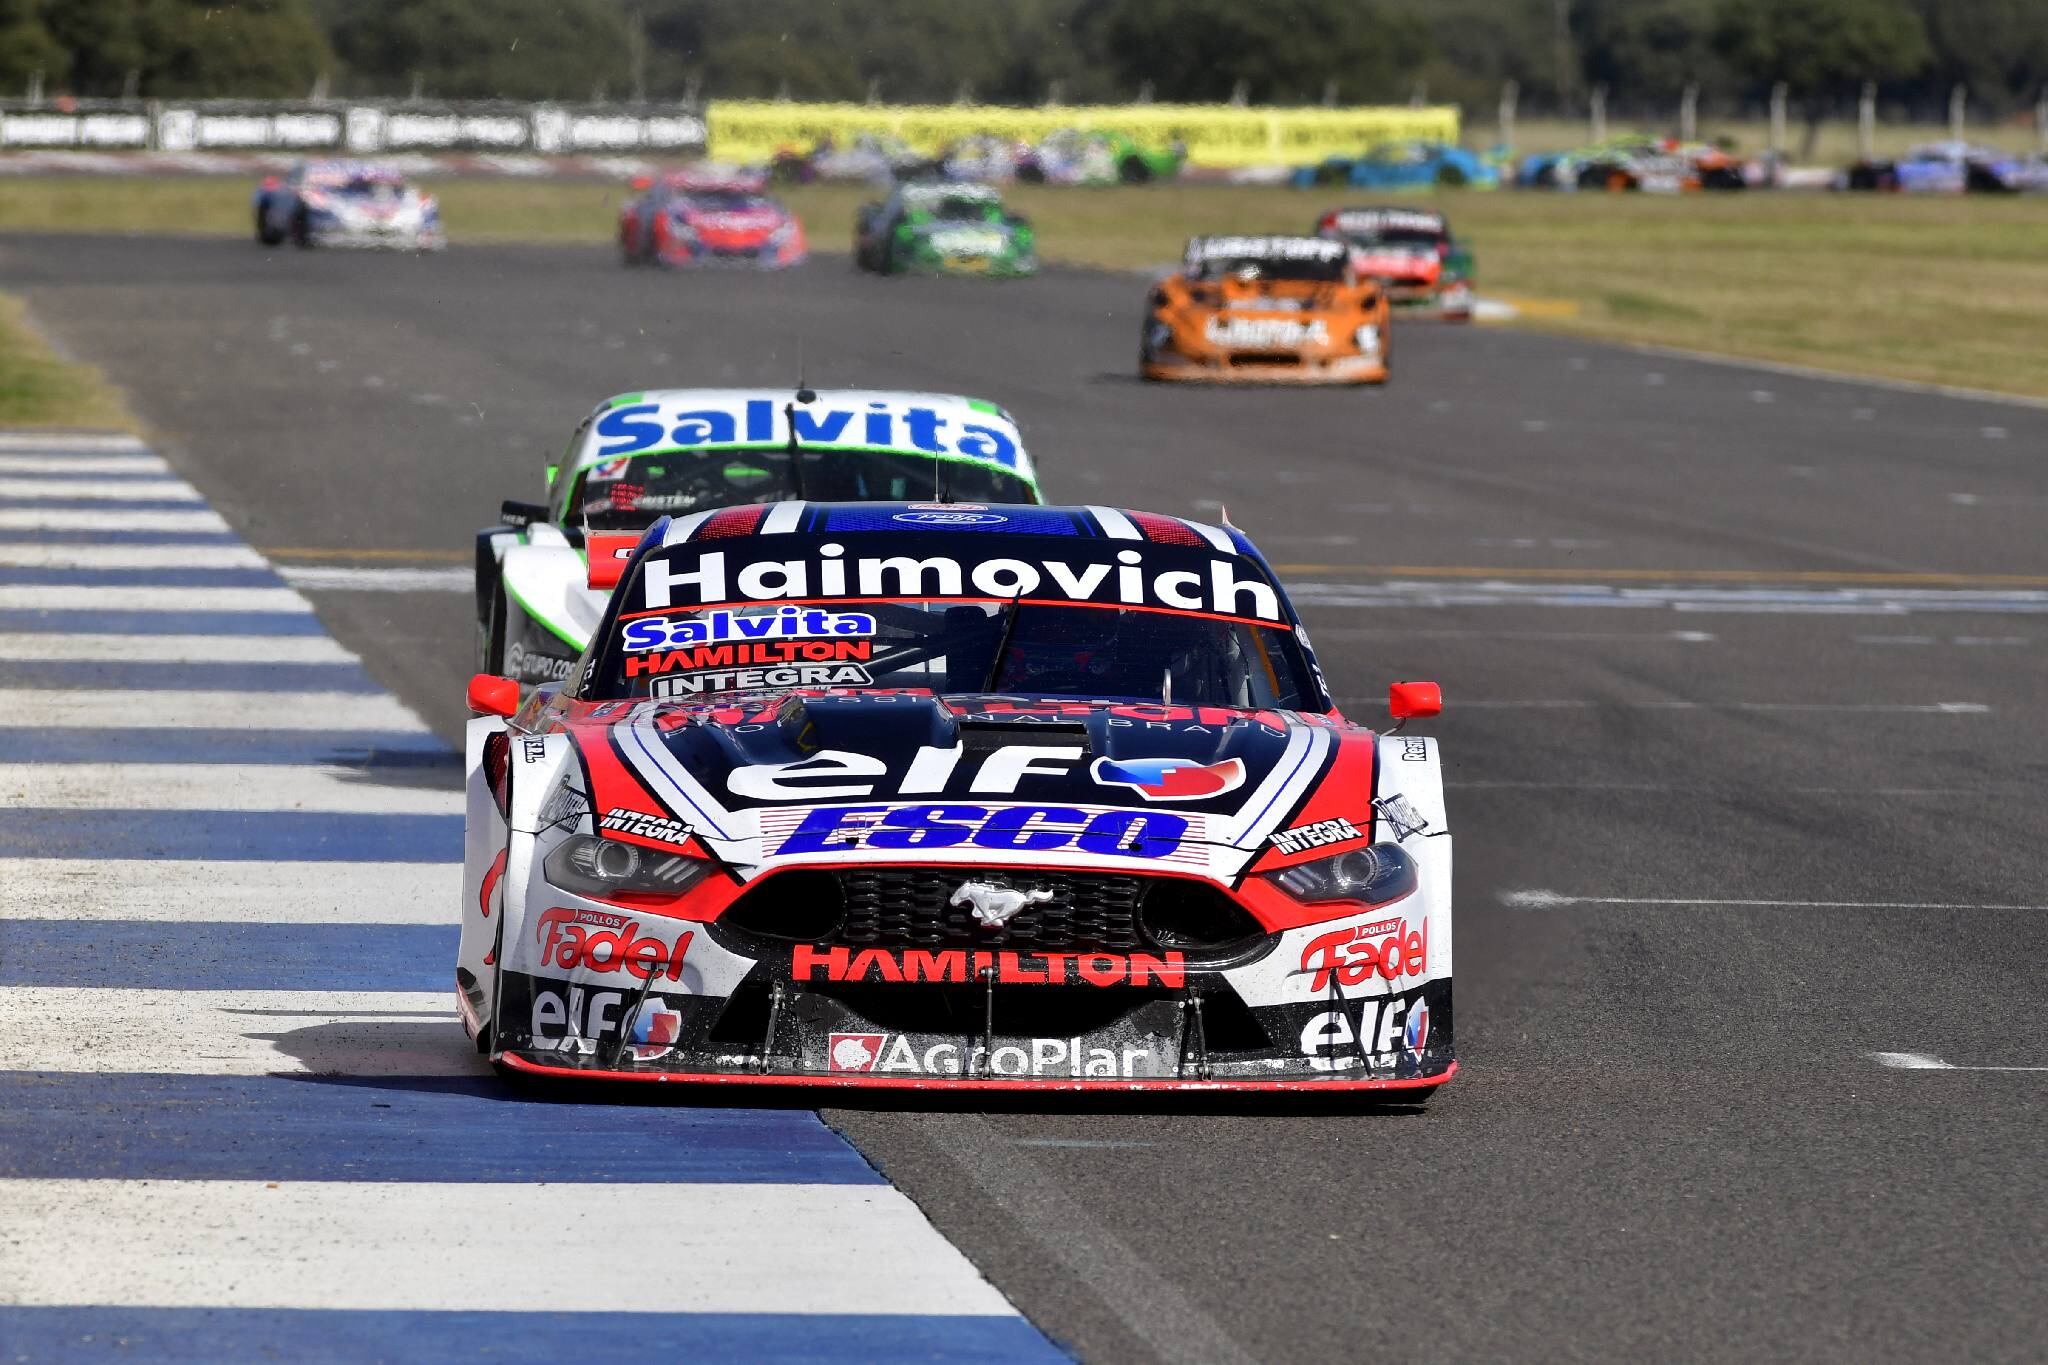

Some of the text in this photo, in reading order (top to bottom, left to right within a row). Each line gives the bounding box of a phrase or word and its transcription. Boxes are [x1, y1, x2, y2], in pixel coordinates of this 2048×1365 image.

[597, 400, 1018, 467] Salvita
[644, 543, 1280, 622] Haimovich
[624, 606, 875, 650] Salvita
[625, 641, 871, 678] HAMILTON
[656, 667, 865, 699] INTEGRA
[599, 808, 695, 845] INTEGRA
[773, 805, 1190, 858] ESCO
[1267, 818, 1363, 855] INTEGRA
[579, 913, 621, 928] POLLOS
[1361, 921, 1397, 937] POLLOS
[537, 906, 695, 982] Fadel
[792, 944, 1185, 988] HAMILTON
[1301, 915, 1428, 992] Fadel
